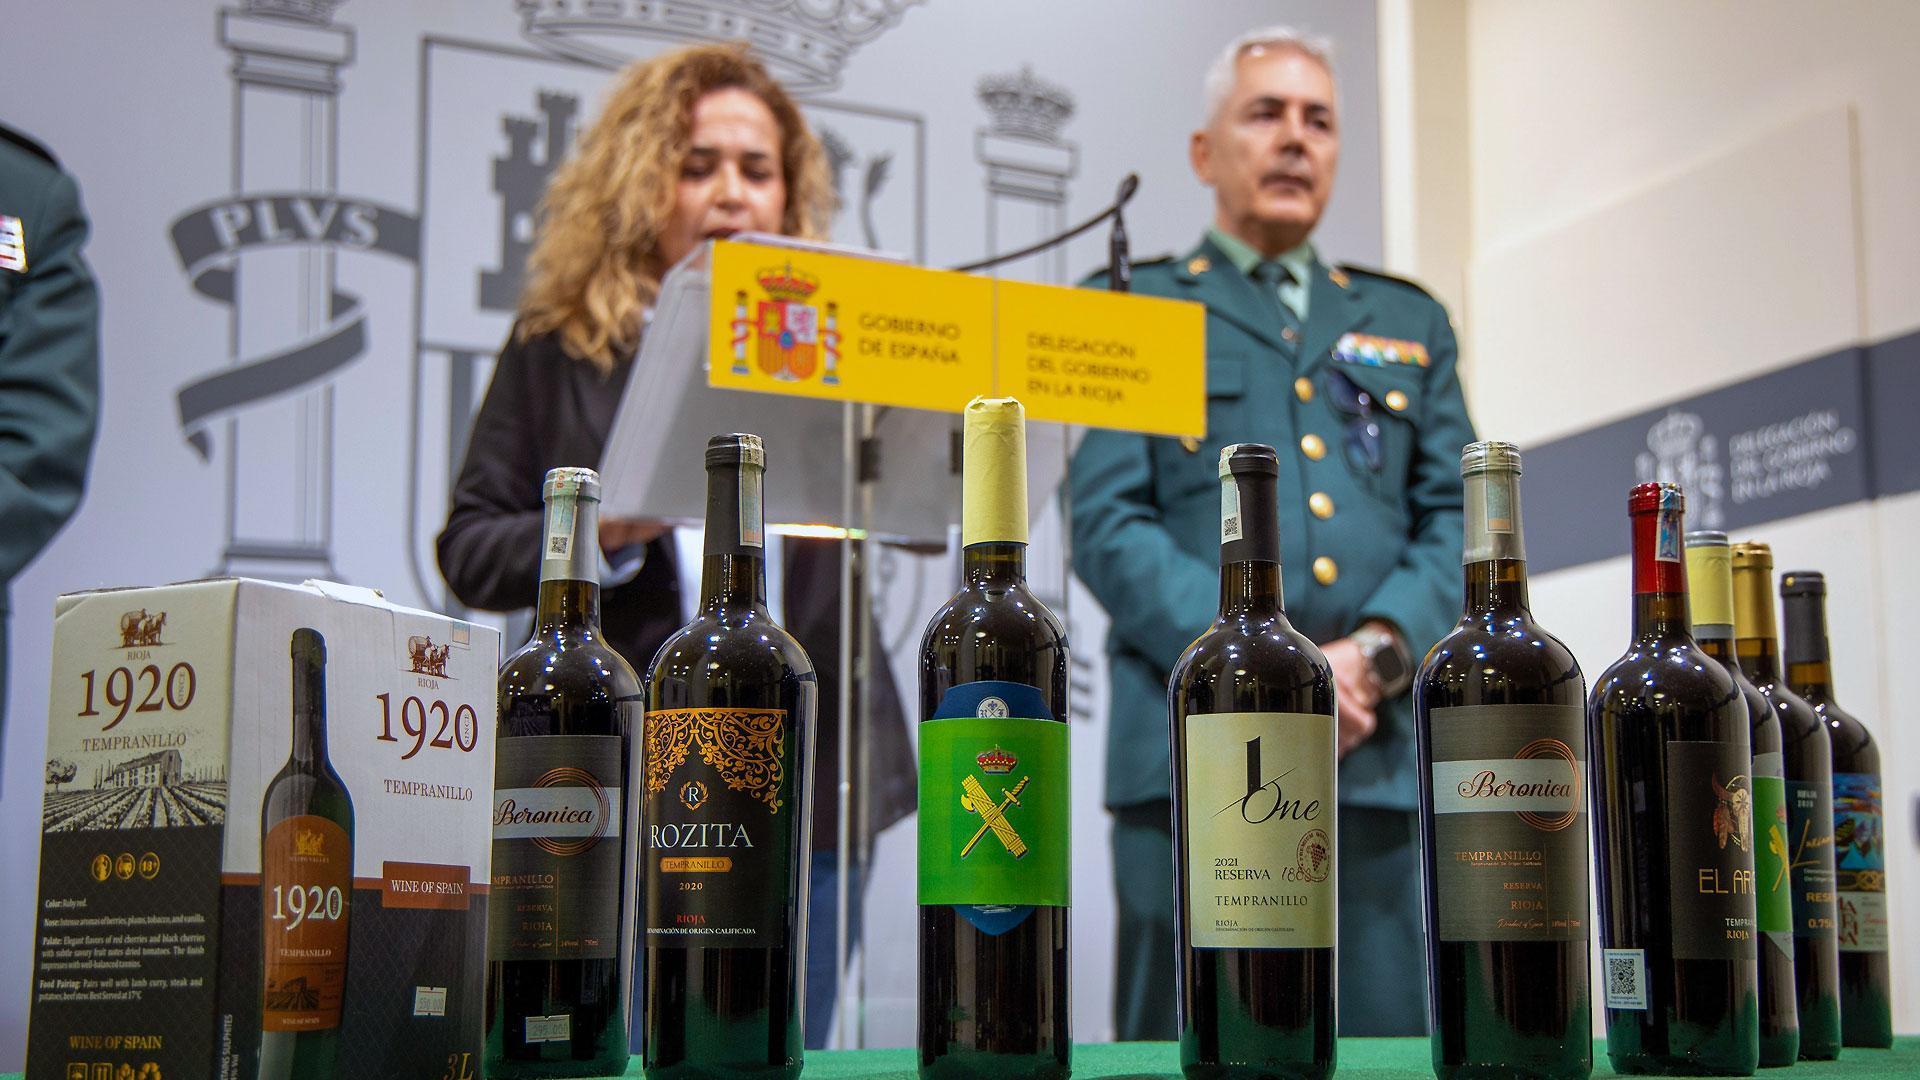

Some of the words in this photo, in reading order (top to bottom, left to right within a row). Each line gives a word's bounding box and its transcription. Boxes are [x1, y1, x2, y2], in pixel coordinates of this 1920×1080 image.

[209, 200, 378, 248] PLVS
[858, 312, 960, 341] GOBIERNO
[858, 338, 883, 357] DE
[890, 339, 960, 365] ESPAÑA
[1027, 331, 1136, 360] DELEGACIÓN
[1027, 357, 1056, 376] DEL
[1062, 359, 1151, 385] GOBIERNO
[1027, 379, 1047, 397] EN
[1050, 381, 1073, 400] LA
[1078, 384, 1124, 405] RIOJA
[127, 650, 151, 661] RIOJA
[178, 671, 186, 702] SINCE
[418, 678, 440, 690] RIOJA
[78, 661, 196, 732] 1920
[376, 692, 479, 761] 1920
[82, 733, 187, 752] TEMPRANILLO
[384, 779, 473, 802] TEMPRANILLO
[1457, 770, 1572, 799] Beronica
[688, 786, 699, 802] R
[1241, 781, 1321, 824] One
[493, 798, 595, 826] Beronica
[651, 823, 754, 848] ROZITA
[1215, 857, 1239, 867] 2021
[1455, 850, 1542, 861] TEMPRANILLO
[665, 859, 725, 870] TEMPRANILLO
[1215, 869, 1271, 881] RESERVA
[1699, 868, 1729, 894] EL
[391, 879, 419, 893] WINE
[421, 881, 435, 893] OF
[436, 881, 464, 895] SPAIN
[679, 882, 704, 891] 2020
[1503, 882, 1543, 890] RESERVA
[272, 885, 343, 931] 1920
[516, 903, 553, 912] RESERVA
[1215, 895, 1308, 906] TEMPRANILLO
[1511, 900, 1543, 910] RIOJA
[676, 913, 706, 925] RIOJA
[1215, 920, 1239, 928] RIOJA
[680, 927, 688, 935] DE
[689, 927, 714, 935] ORIGEN
[1726, 930, 1749, 940] RIOJA
[280, 948, 332, 957] TEMPRANILLO
[69, 1036, 102, 1049] WINE
[104, 1036, 122, 1049] OF
[124, 1035, 162, 1048] SPAIN
